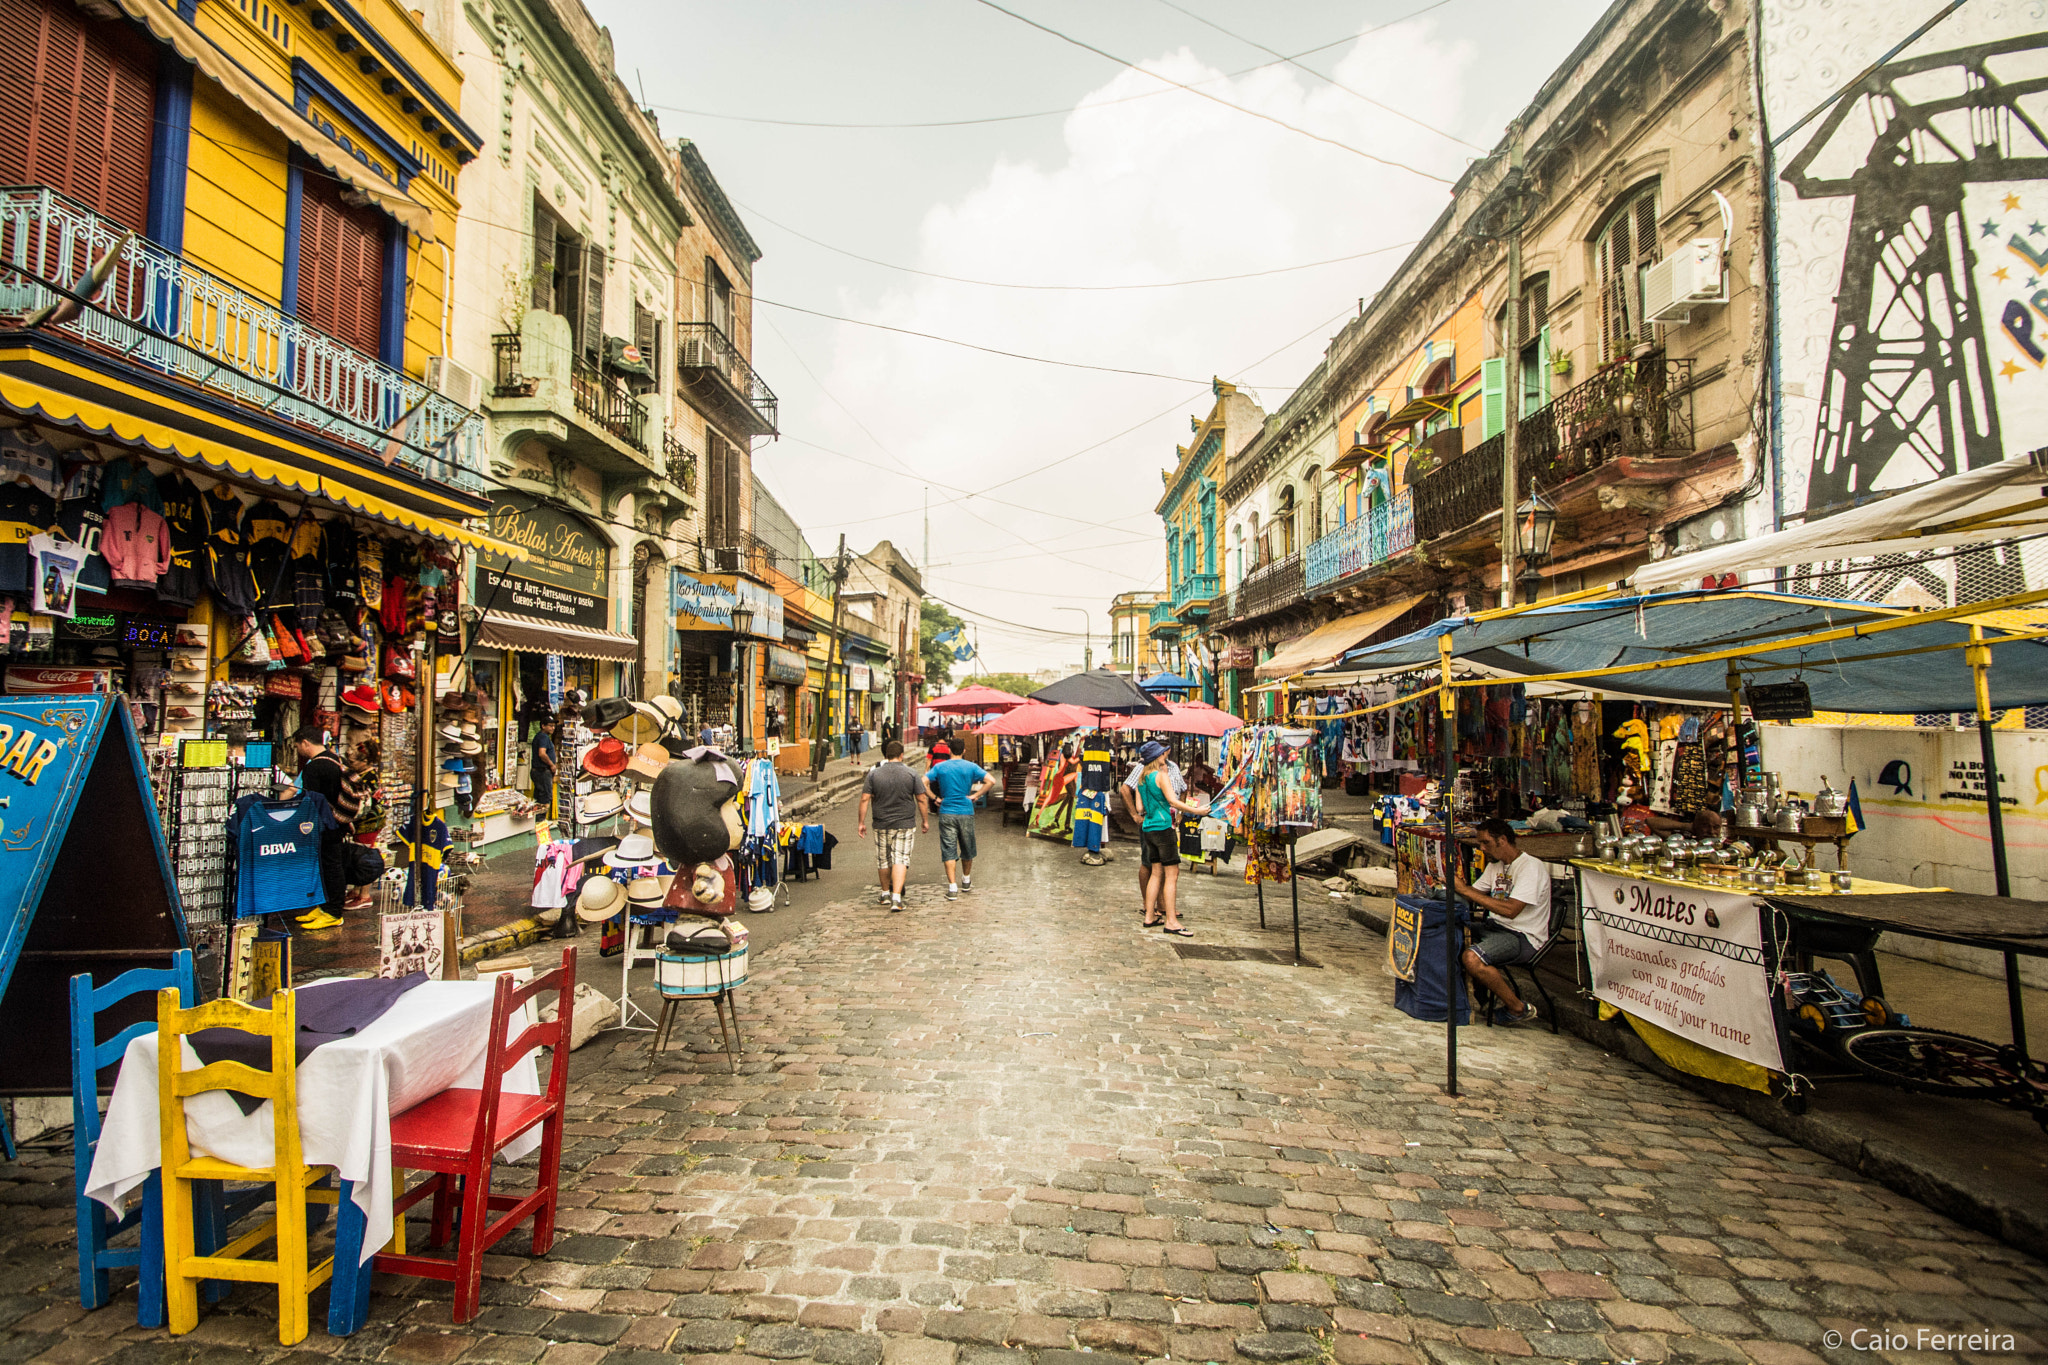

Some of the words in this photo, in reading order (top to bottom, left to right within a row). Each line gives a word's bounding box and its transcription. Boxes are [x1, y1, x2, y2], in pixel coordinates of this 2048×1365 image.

[83, 509, 104, 524] MESS
[163, 501, 193, 521] BOCA
[494, 504, 549, 553] Bellas
[549, 523, 595, 567] Artes
[677, 580, 737, 599] Costumbres
[128, 627, 169, 644] BOCA
[36, 670, 81, 683] Coca-Cola
[1953, 760, 1967, 770] LA
[1949, 770, 1964, 780] NO
[1965, 771, 2006, 783] OLVA
[1961, 780, 1968, 790] A
[1973, 781, 1987, 791] SU
[259, 842, 297, 857] BBVA
[1629, 885, 1697, 926] Mates
[1396, 906, 1414, 926] BOCA
[1606, 938, 1678, 971] Artesanales
[1680, 960, 1727, 989] grabados
[1632, 967, 1653, 984] con
[1655, 974, 1667, 990] su
[1670, 978, 1706, 1006] nombre
[1607, 979, 1655, 1007] engraved
[1653, 996, 1679, 1019] with
[1678, 1007, 1707, 1032] your
[1709, 1020, 1752, 1046] name
